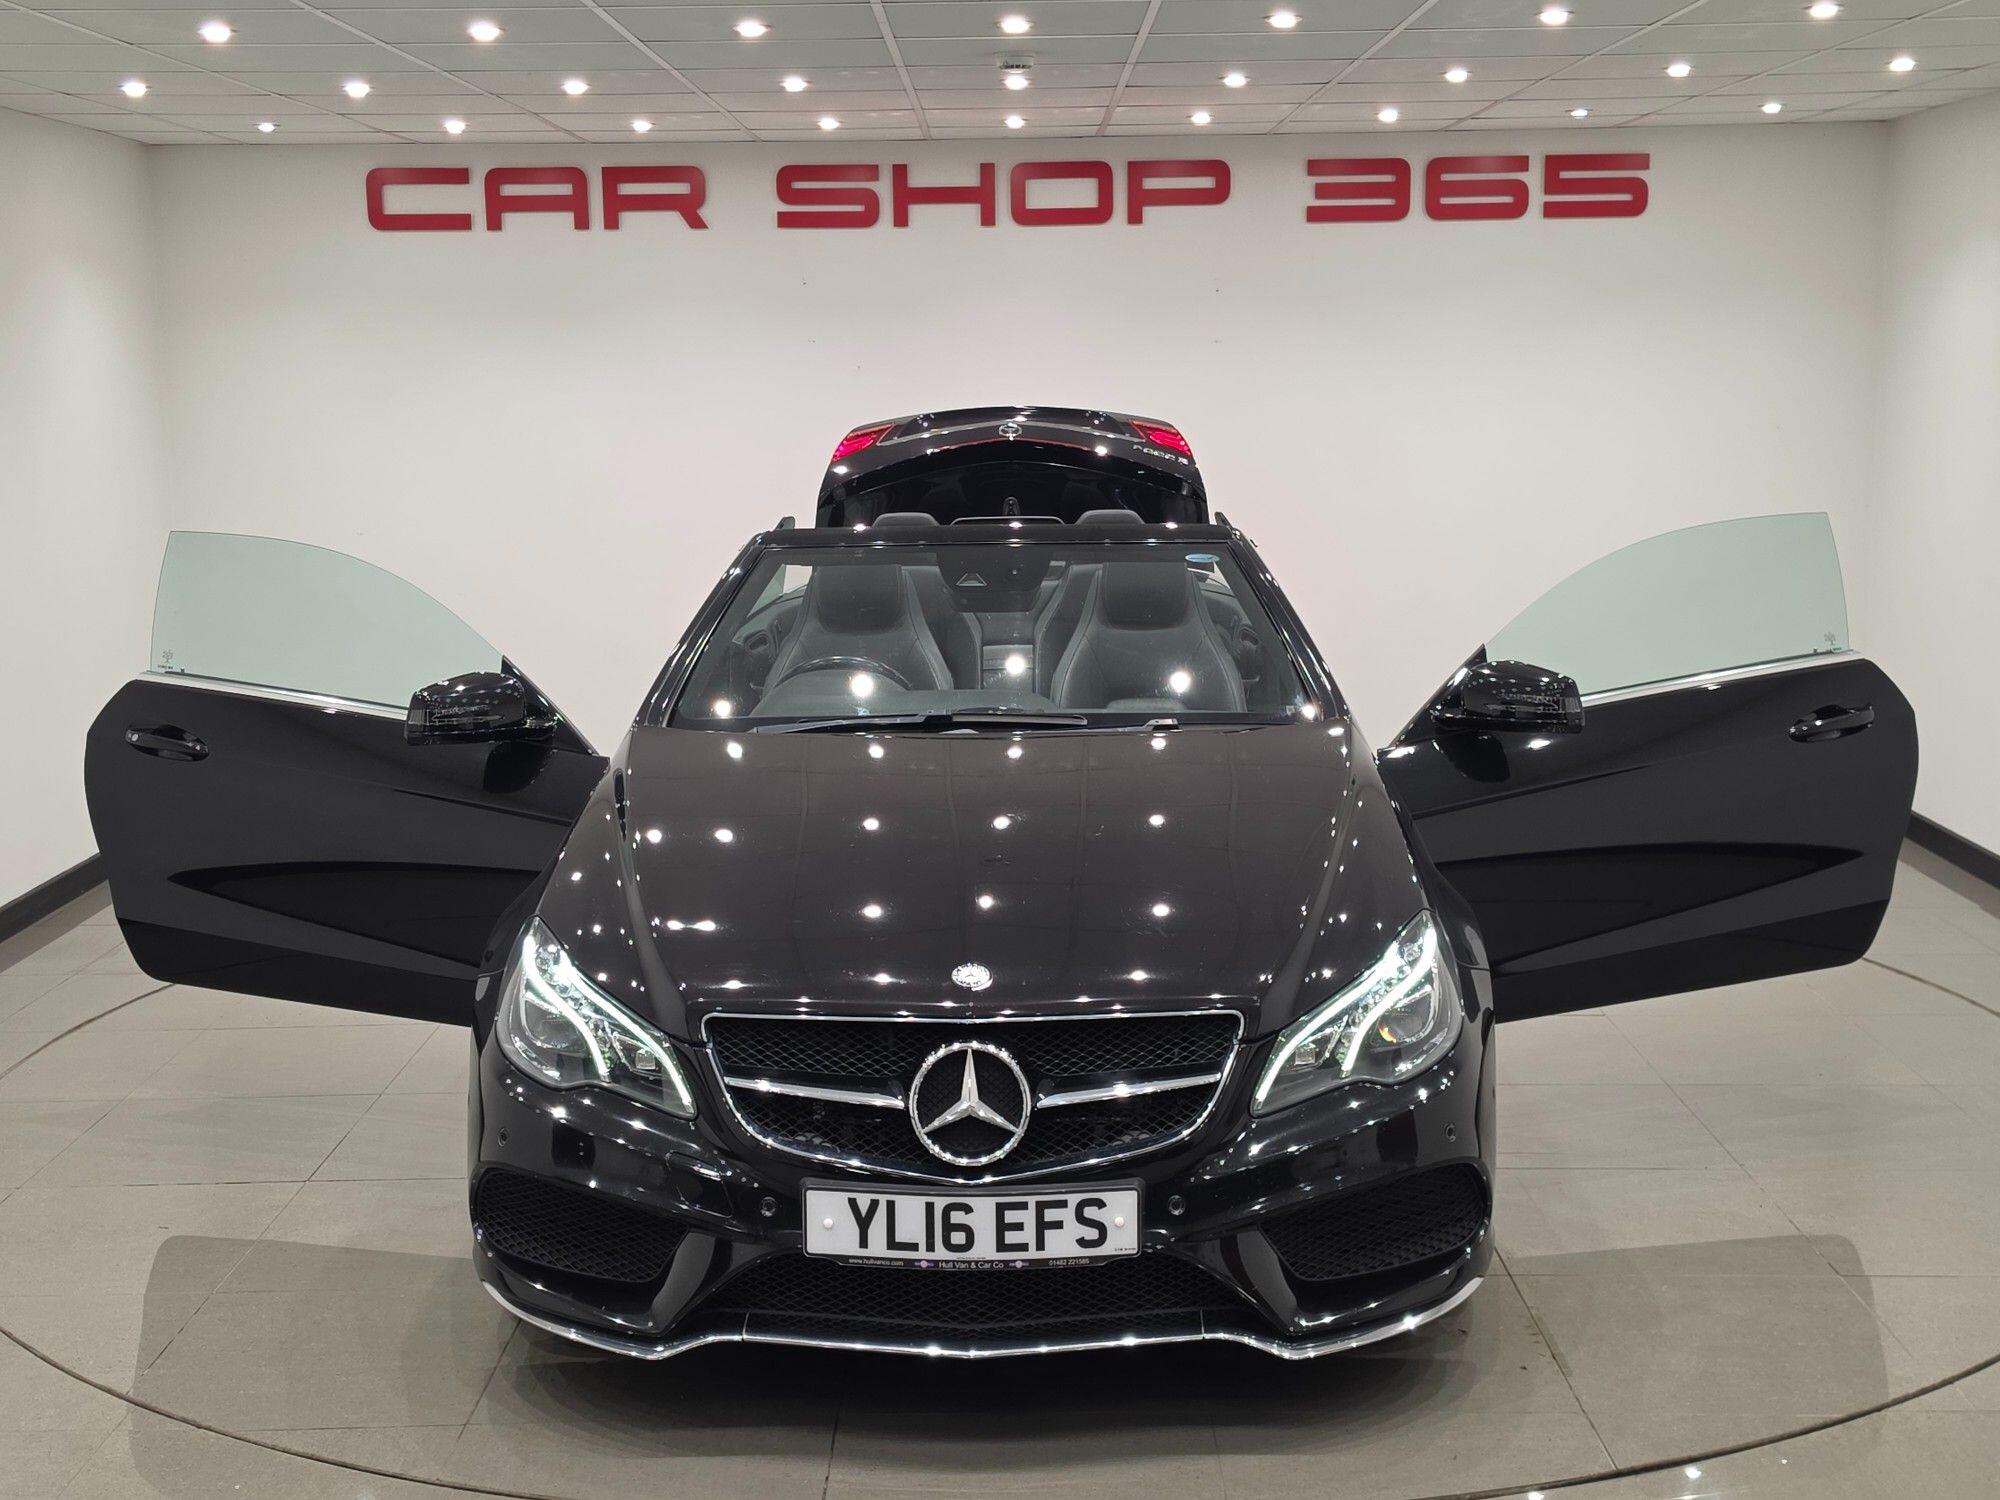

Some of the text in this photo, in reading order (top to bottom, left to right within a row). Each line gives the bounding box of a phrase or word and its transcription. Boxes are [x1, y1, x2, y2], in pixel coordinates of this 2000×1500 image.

[366, 153, 1650, 232] CAR SHOP 365
[848, 1197, 1108, 1253] YL16 EFS
[938, 1261, 1005, 1269] Hull Van & Car Co
